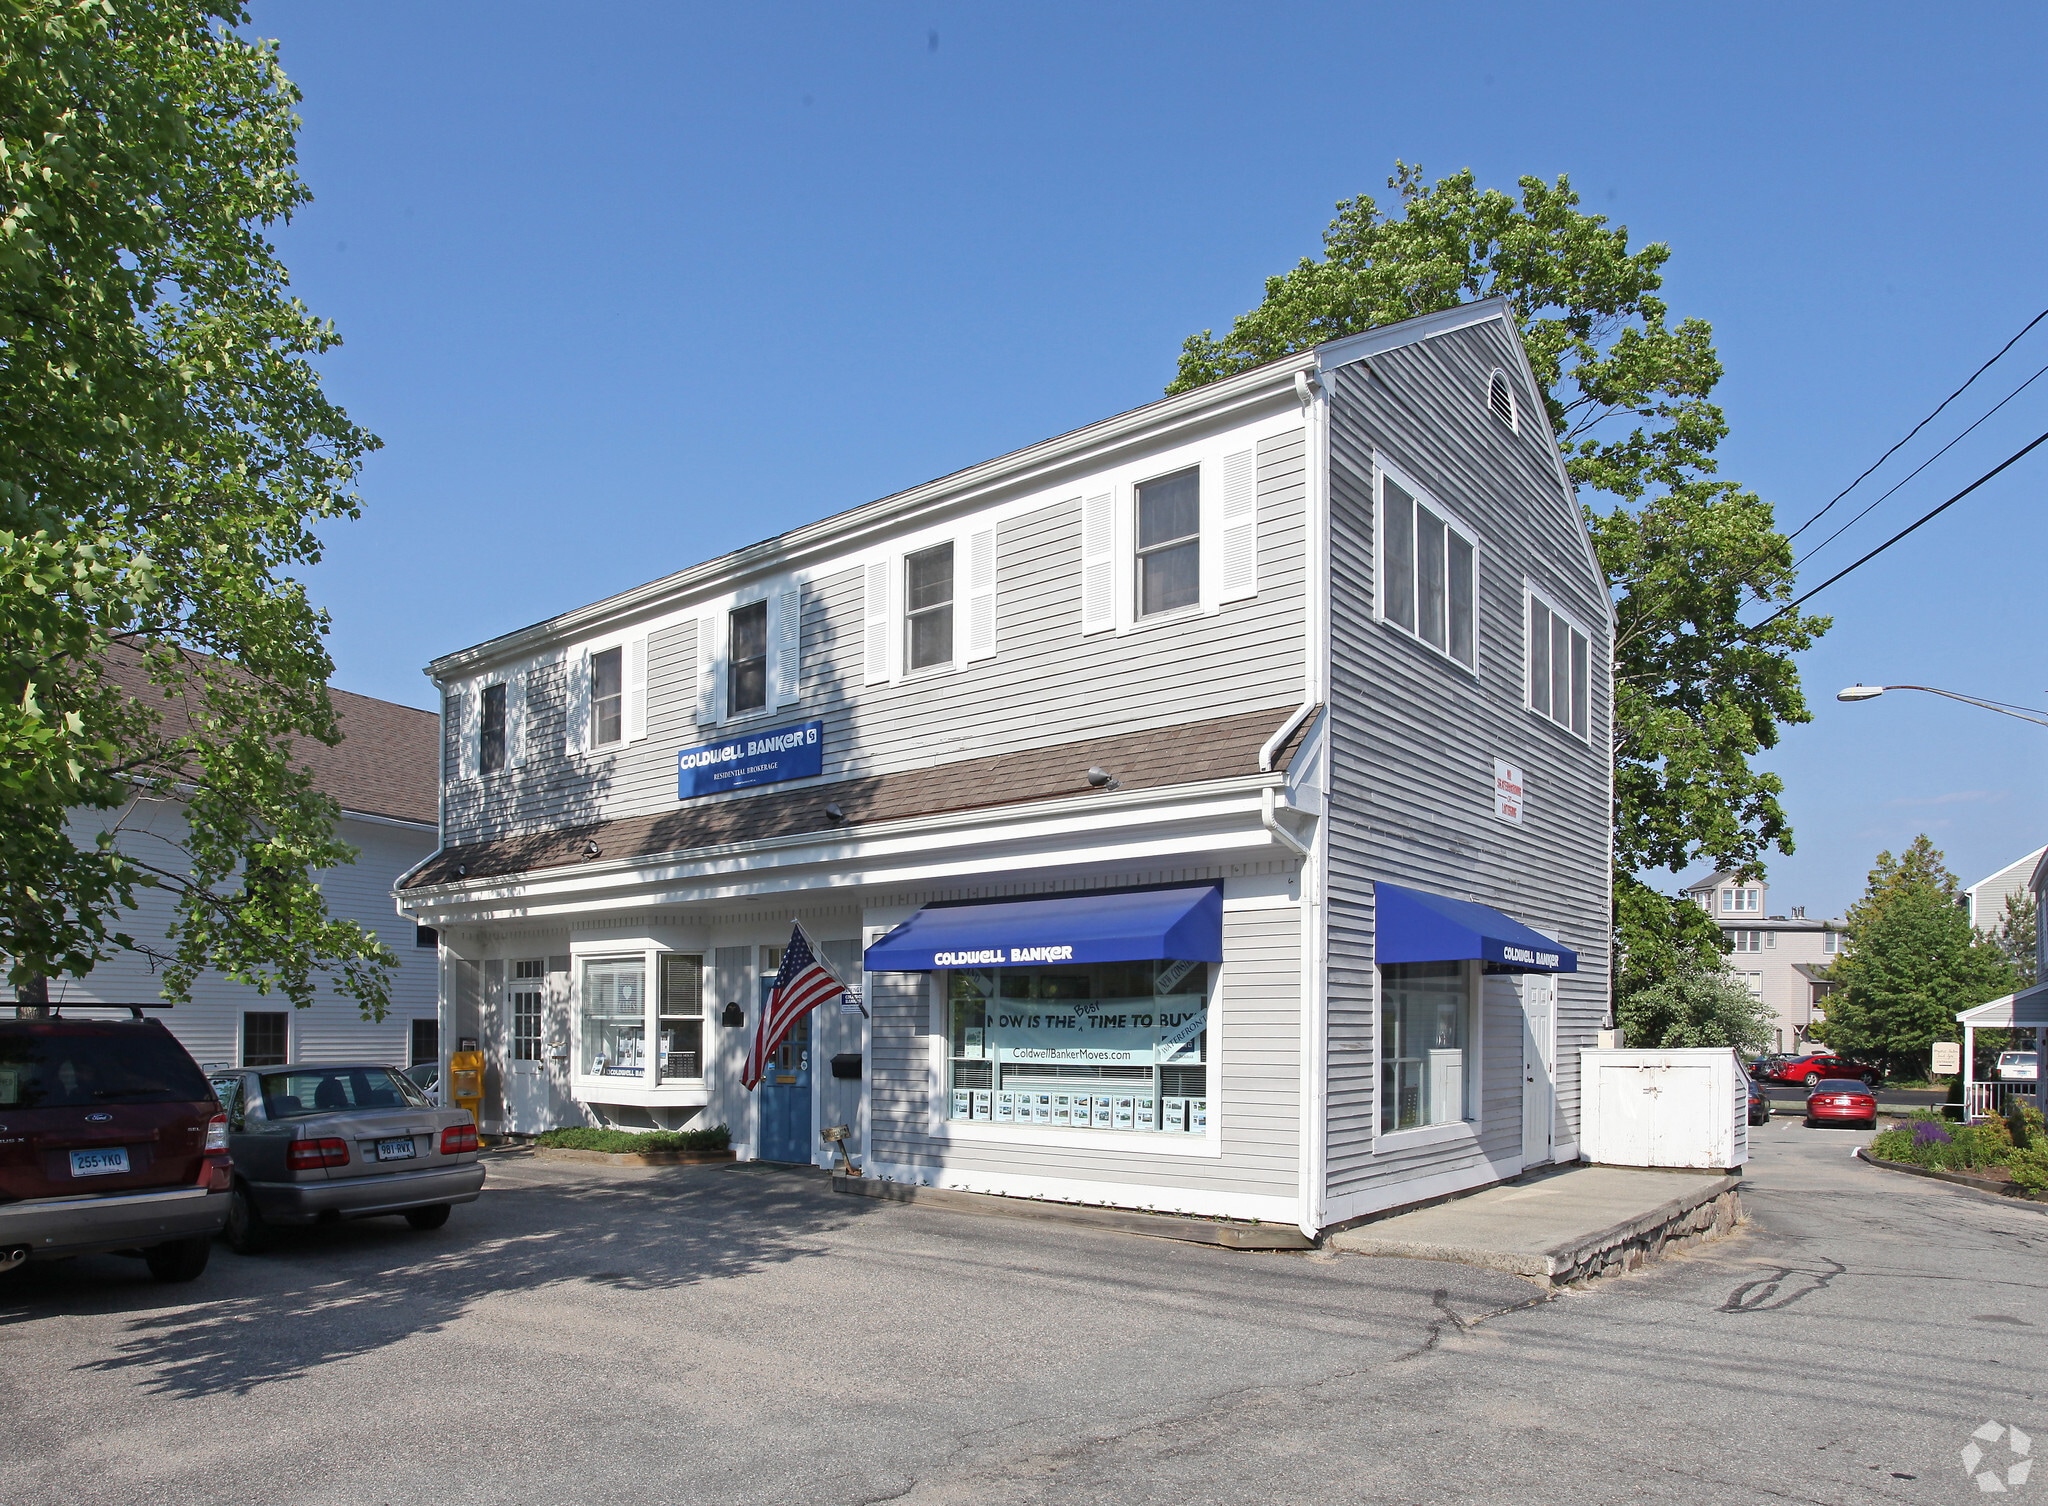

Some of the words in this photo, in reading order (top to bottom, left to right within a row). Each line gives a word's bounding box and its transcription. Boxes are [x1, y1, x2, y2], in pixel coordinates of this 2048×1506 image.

[680, 743, 745, 770] COLDWELL
[747, 730, 804, 756] BANKER
[713, 768, 746, 781] RESIDENTIAL
[746, 761, 778, 775] BROKERAGE
[934, 949, 1006, 965] COLDWELL
[1010, 945, 1073, 963] BANKER
[1503, 946, 1535, 964] COLDWELL
[1536, 951, 1559, 969] BANKER
[1073, 1001, 1101, 1018] Best
[1027, 1015, 1041, 1028] IS
[1045, 1015, 1076, 1028] THE
[1088, 1014, 1127, 1029] TIME
[1131, 1013, 1153, 1028] TO
[1161, 1015, 1207, 1054] WATERFRONT
[1012, 1047, 1131, 1060] ColdwellBankerMoves.com
